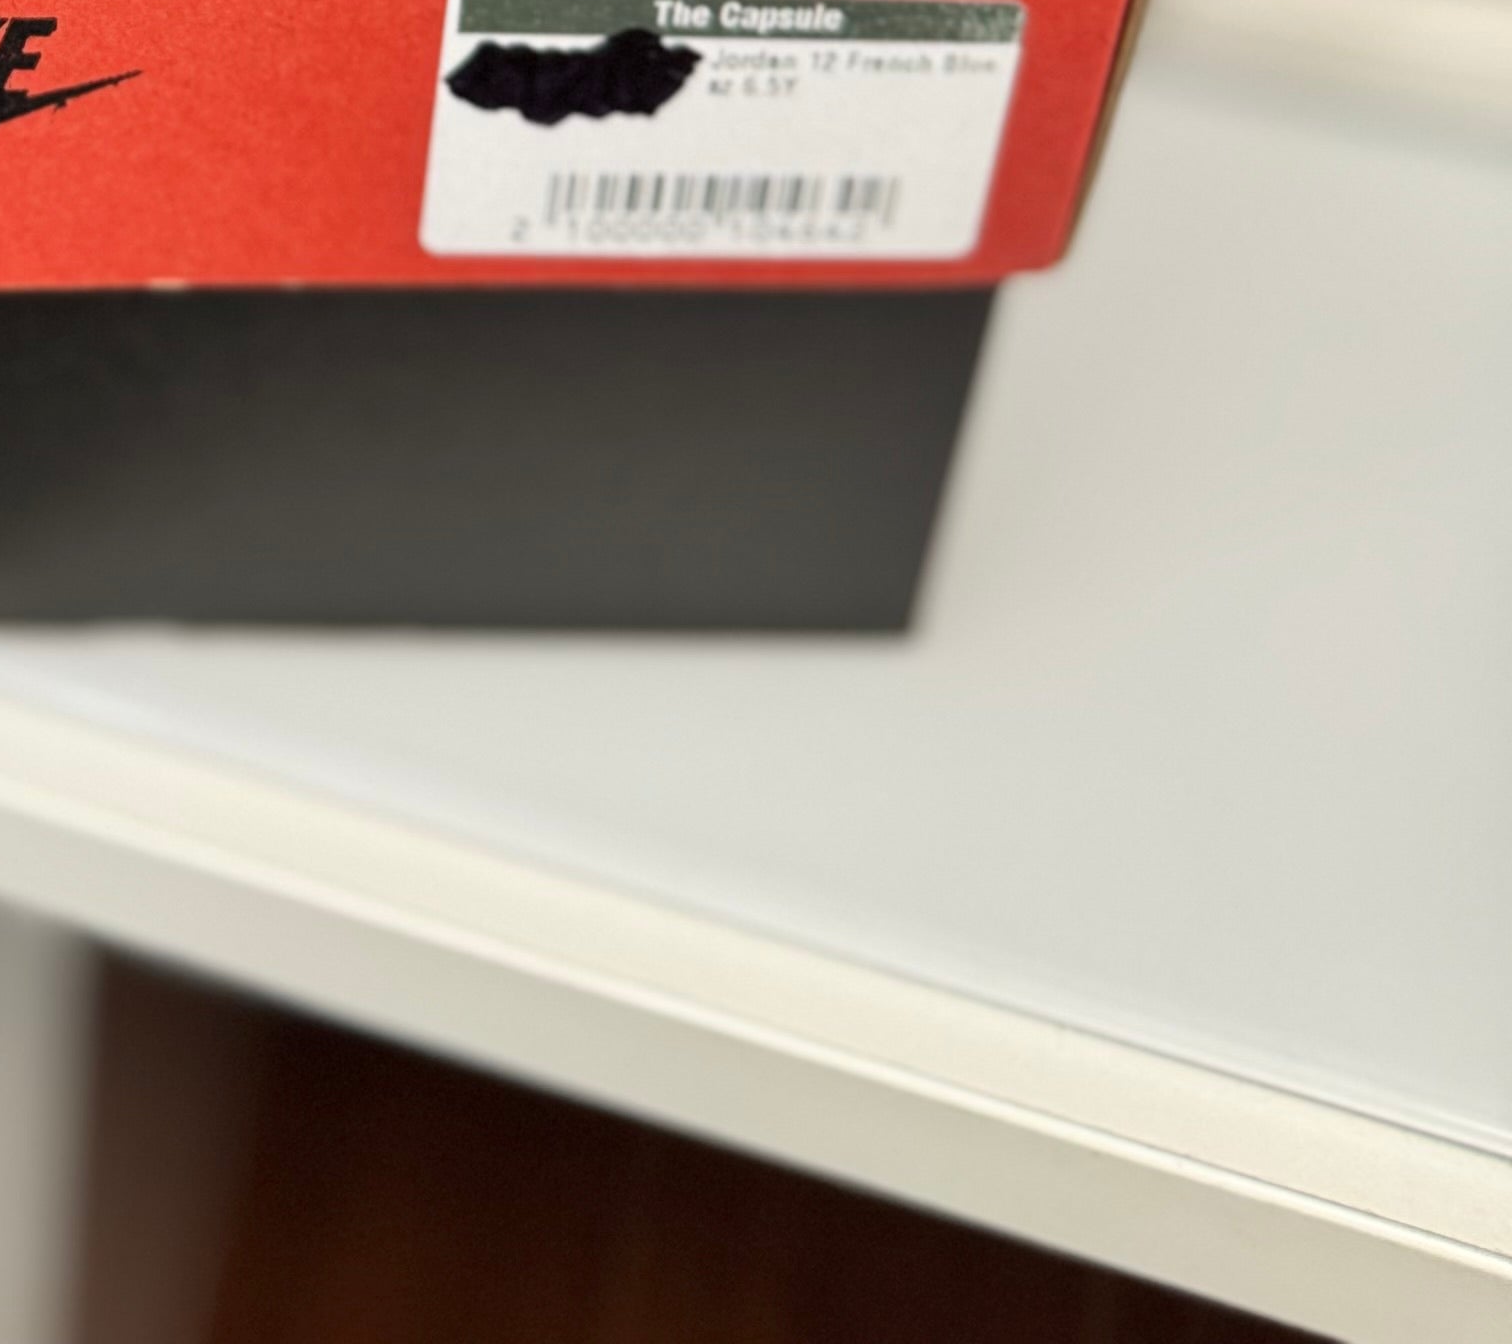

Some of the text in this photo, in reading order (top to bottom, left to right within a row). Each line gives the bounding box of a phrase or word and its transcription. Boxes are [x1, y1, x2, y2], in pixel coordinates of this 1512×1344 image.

[653, 0, 845, 35] The Capsule
[709, 48, 797, 72] Jordan
[811, 50, 839, 74] 12
[845, 50, 934, 74] French
